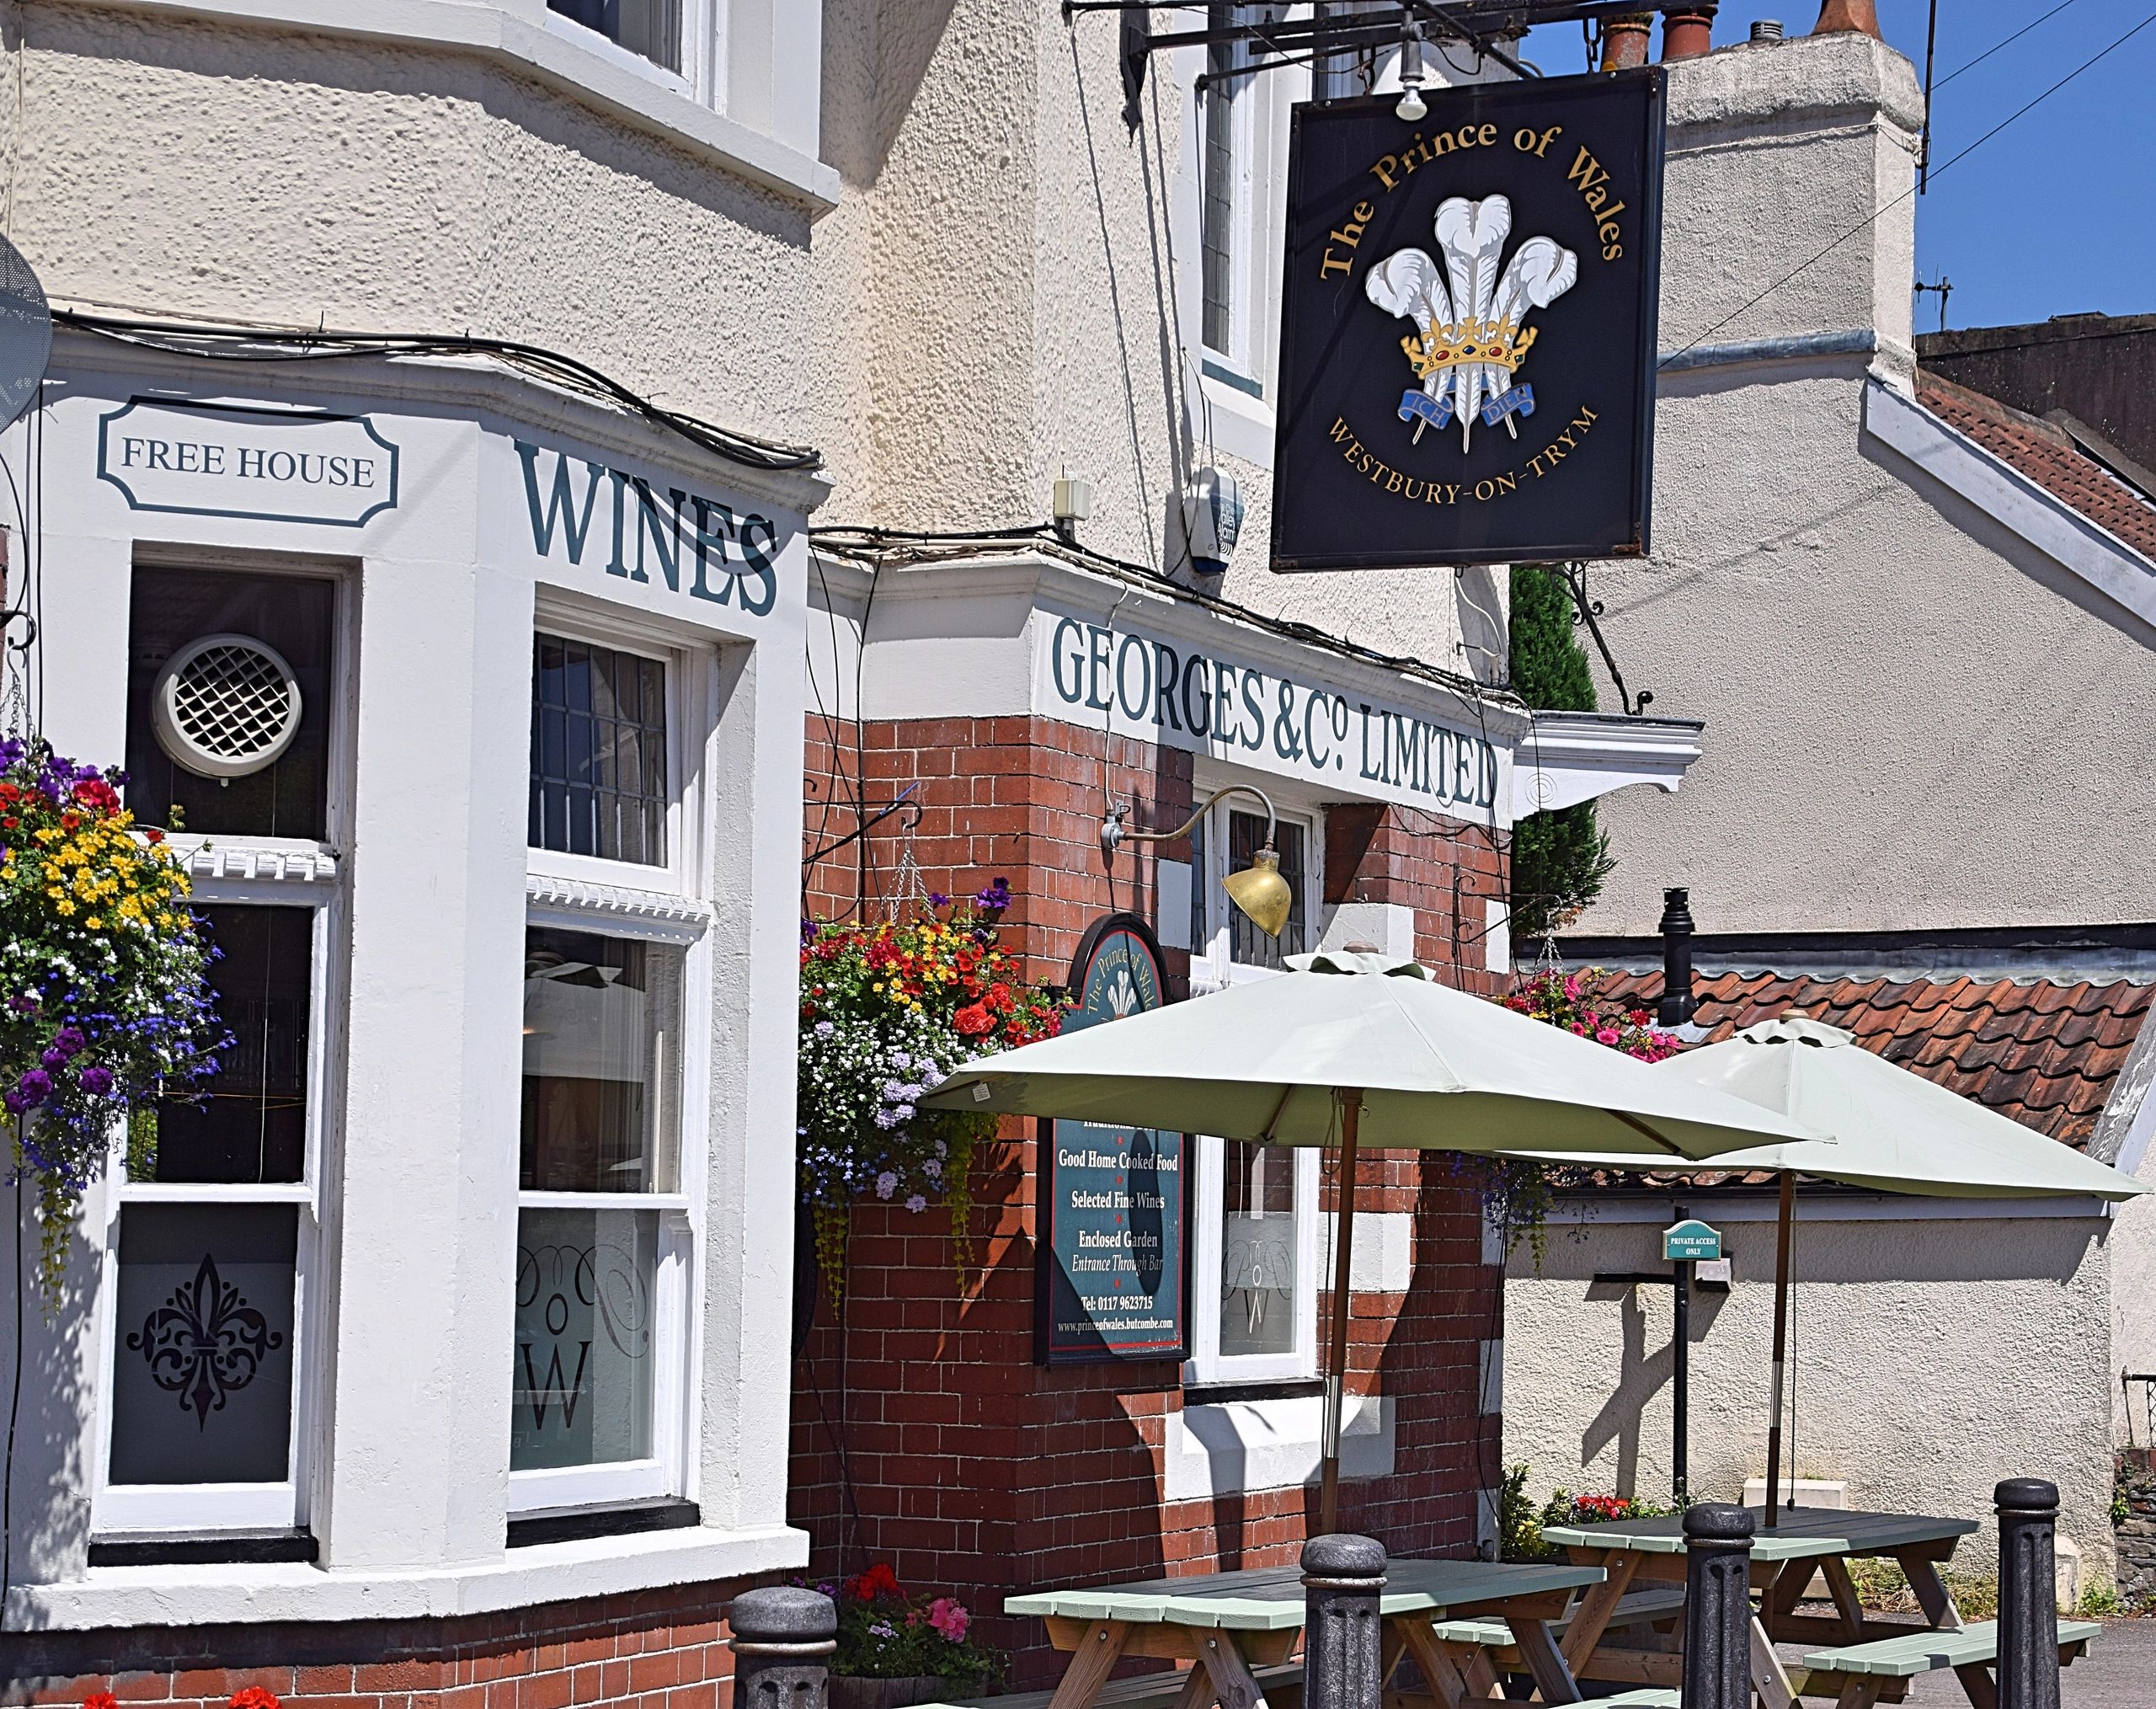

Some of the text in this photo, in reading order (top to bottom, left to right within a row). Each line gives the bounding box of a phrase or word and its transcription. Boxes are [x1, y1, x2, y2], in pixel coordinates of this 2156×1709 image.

[1321, 122, 1626, 280] The Prince of Wales
[1411, 396, 1445, 424] ICH
[120, 436, 375, 488] FREE HOUSE
[514, 438, 777, 617] WINES
[1052, 617, 1264, 751] GEORGES
[1359, 702, 1499, 809] LIMITED
[1087, 948, 1155, 1015] The Prince of Wale
[1059, 1149, 1178, 1171] Good Home Cooked Food
[1071, 1190, 1165, 1209] Selected Fine Wines
[1079, 1230, 1158, 1247] Enclosed Garden
[1071, 1254, 1163, 1277] Entrance Through Bar
[1081, 1295, 1153, 1311] Tel: 0117 9623715
[1058, 1316, 1173, 1335] www.princeofwales.butcombe.com
